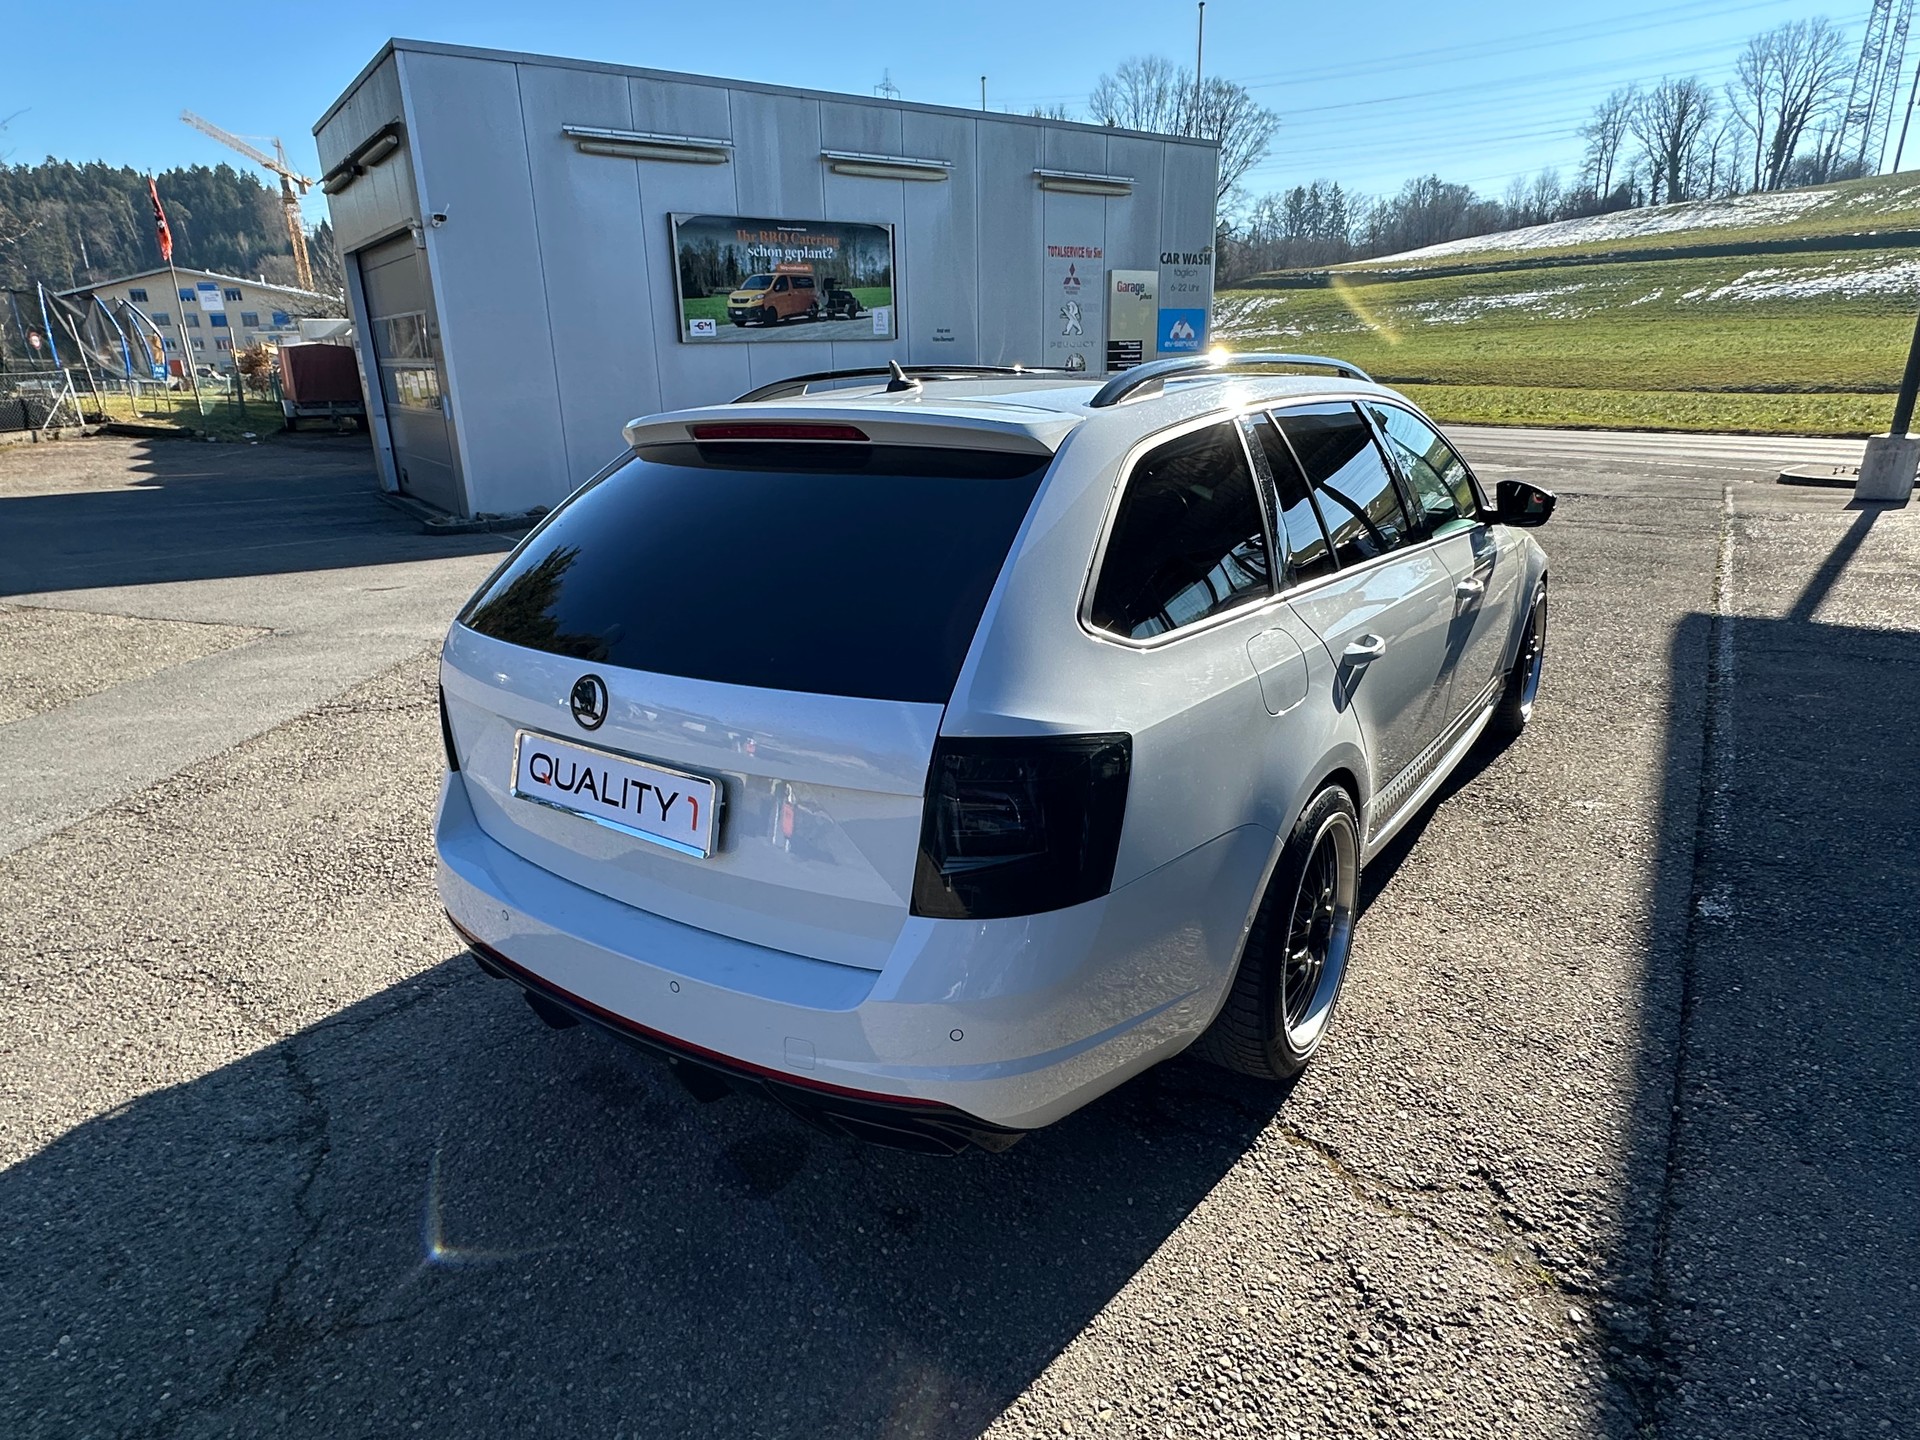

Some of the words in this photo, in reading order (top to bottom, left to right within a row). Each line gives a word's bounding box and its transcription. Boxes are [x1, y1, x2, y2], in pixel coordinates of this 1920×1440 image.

[736, 229, 757, 243] Ihr
[760, 230, 789, 246] BBQ
[791, 232, 840, 249] Catering
[747, 245, 782, 258] schon
[785, 246, 833, 262] geplant?
[1048, 245, 1084, 258] TOTALSERVICE
[1160, 252, 1179, 265] CAR
[1182, 253, 1211, 265] WASH
[1117, 280, 1145, 295] Garage
[1050, 340, 1095, 348] PEUGEOT
[530, 753, 679, 821] QUALITY
[687, 796, 698, 831] 1
